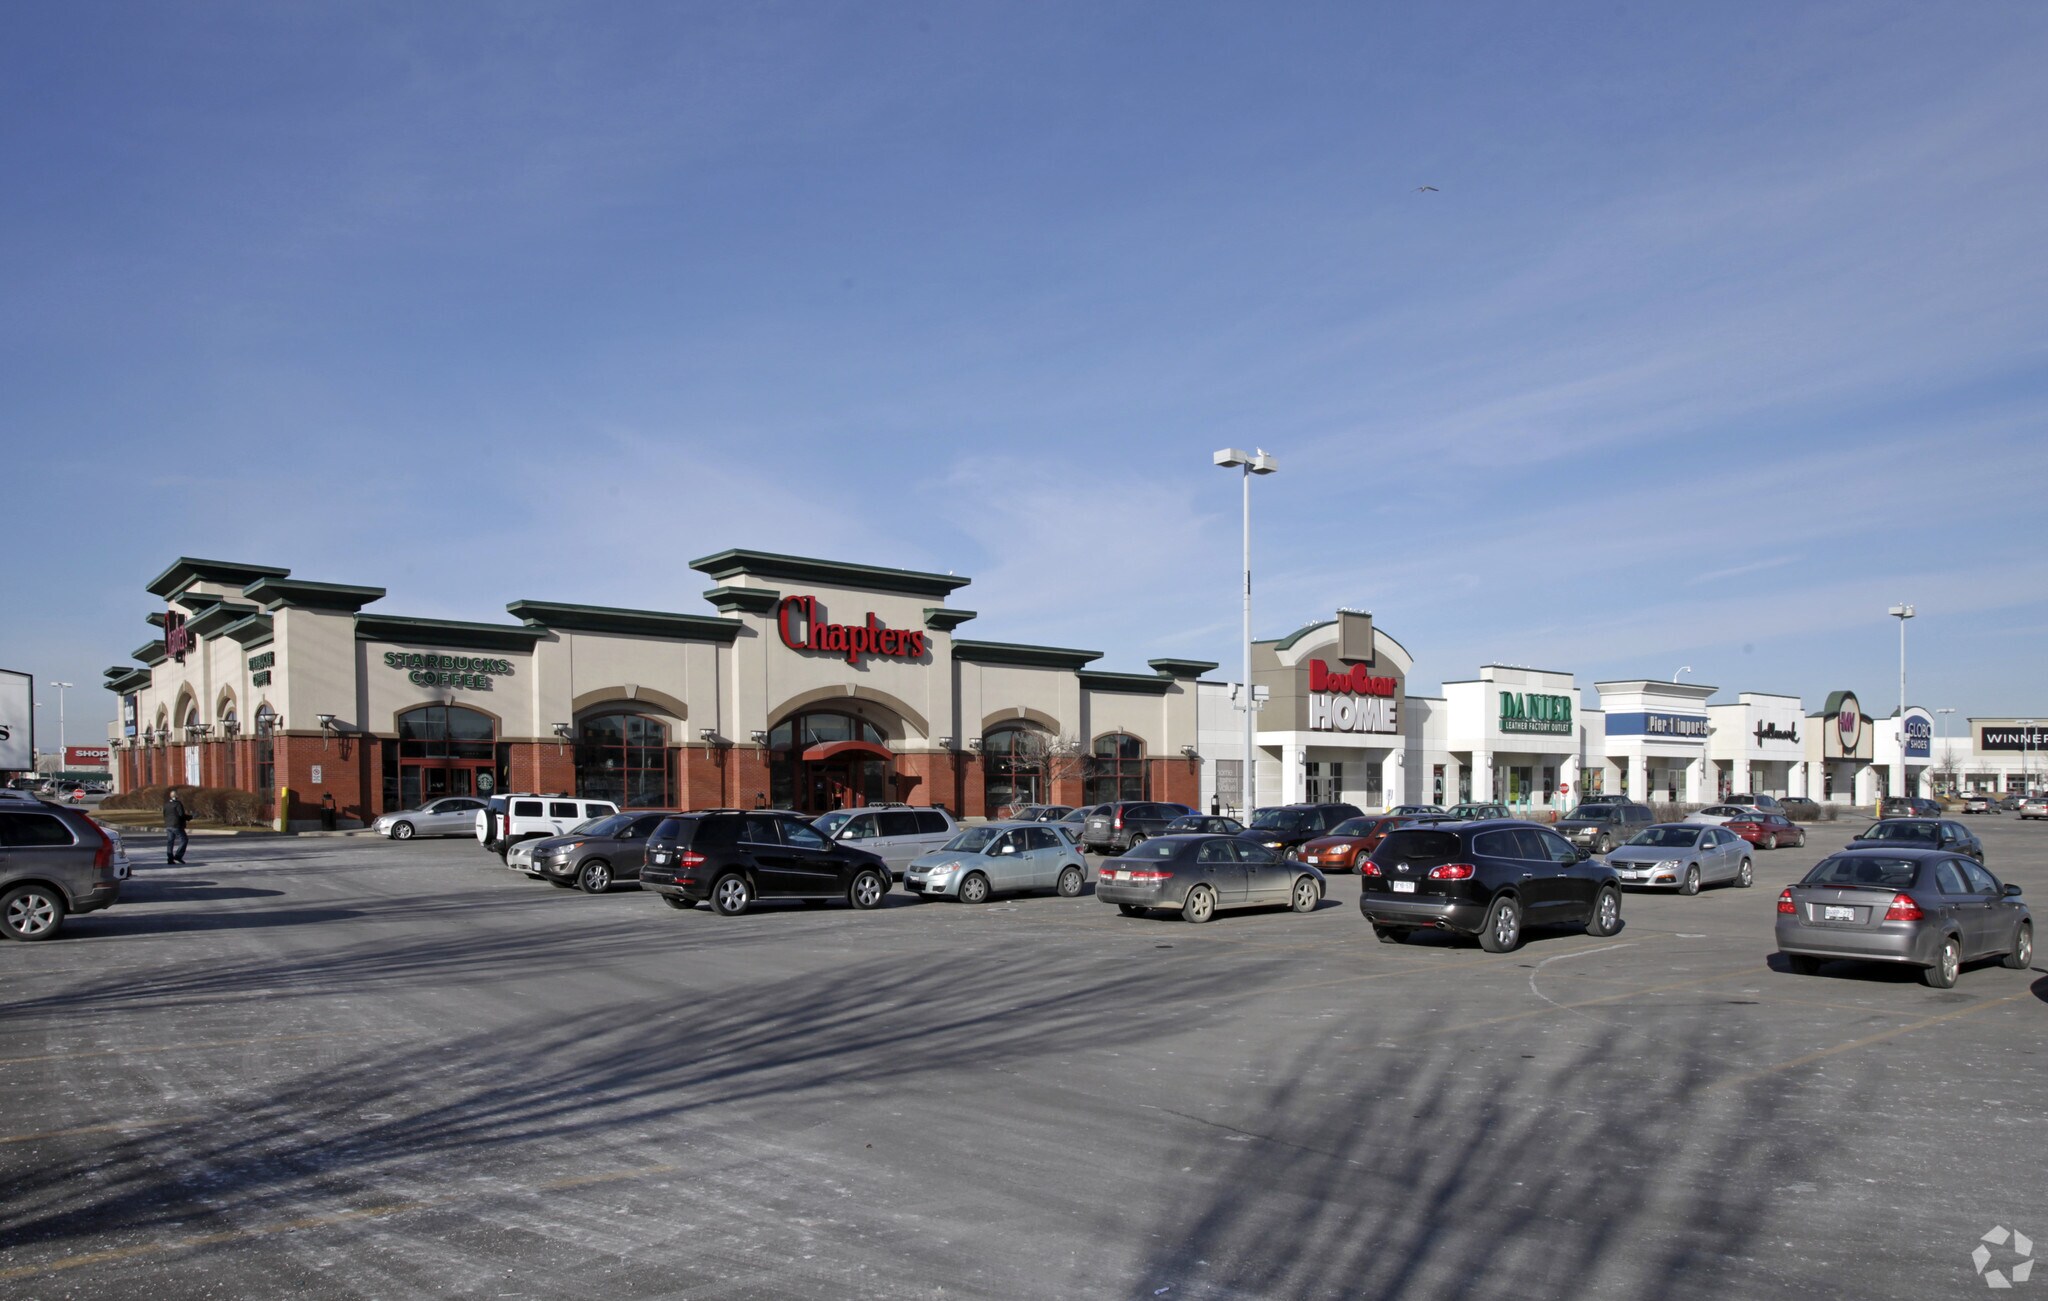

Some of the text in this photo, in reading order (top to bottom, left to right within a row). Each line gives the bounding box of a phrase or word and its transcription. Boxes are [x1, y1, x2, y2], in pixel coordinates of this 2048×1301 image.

[777, 595, 925, 663] Chapters
[384, 651, 510, 673] STARBUCKS
[408, 670, 488, 688] COFFEE
[1309, 694, 1397, 733] HOME
[1499, 691, 1571, 721] DANIER
[1505, 722, 1569, 732] LEATHER FACTORY OUTLET
[1649, 715, 1667, 732] Pier
[1677, 718, 1708, 736] imports
[1753, 719, 1800, 748] Hallmark
[1908, 722, 1931, 738] GLOBO
[1910, 740, 1927, 749] SHOES
